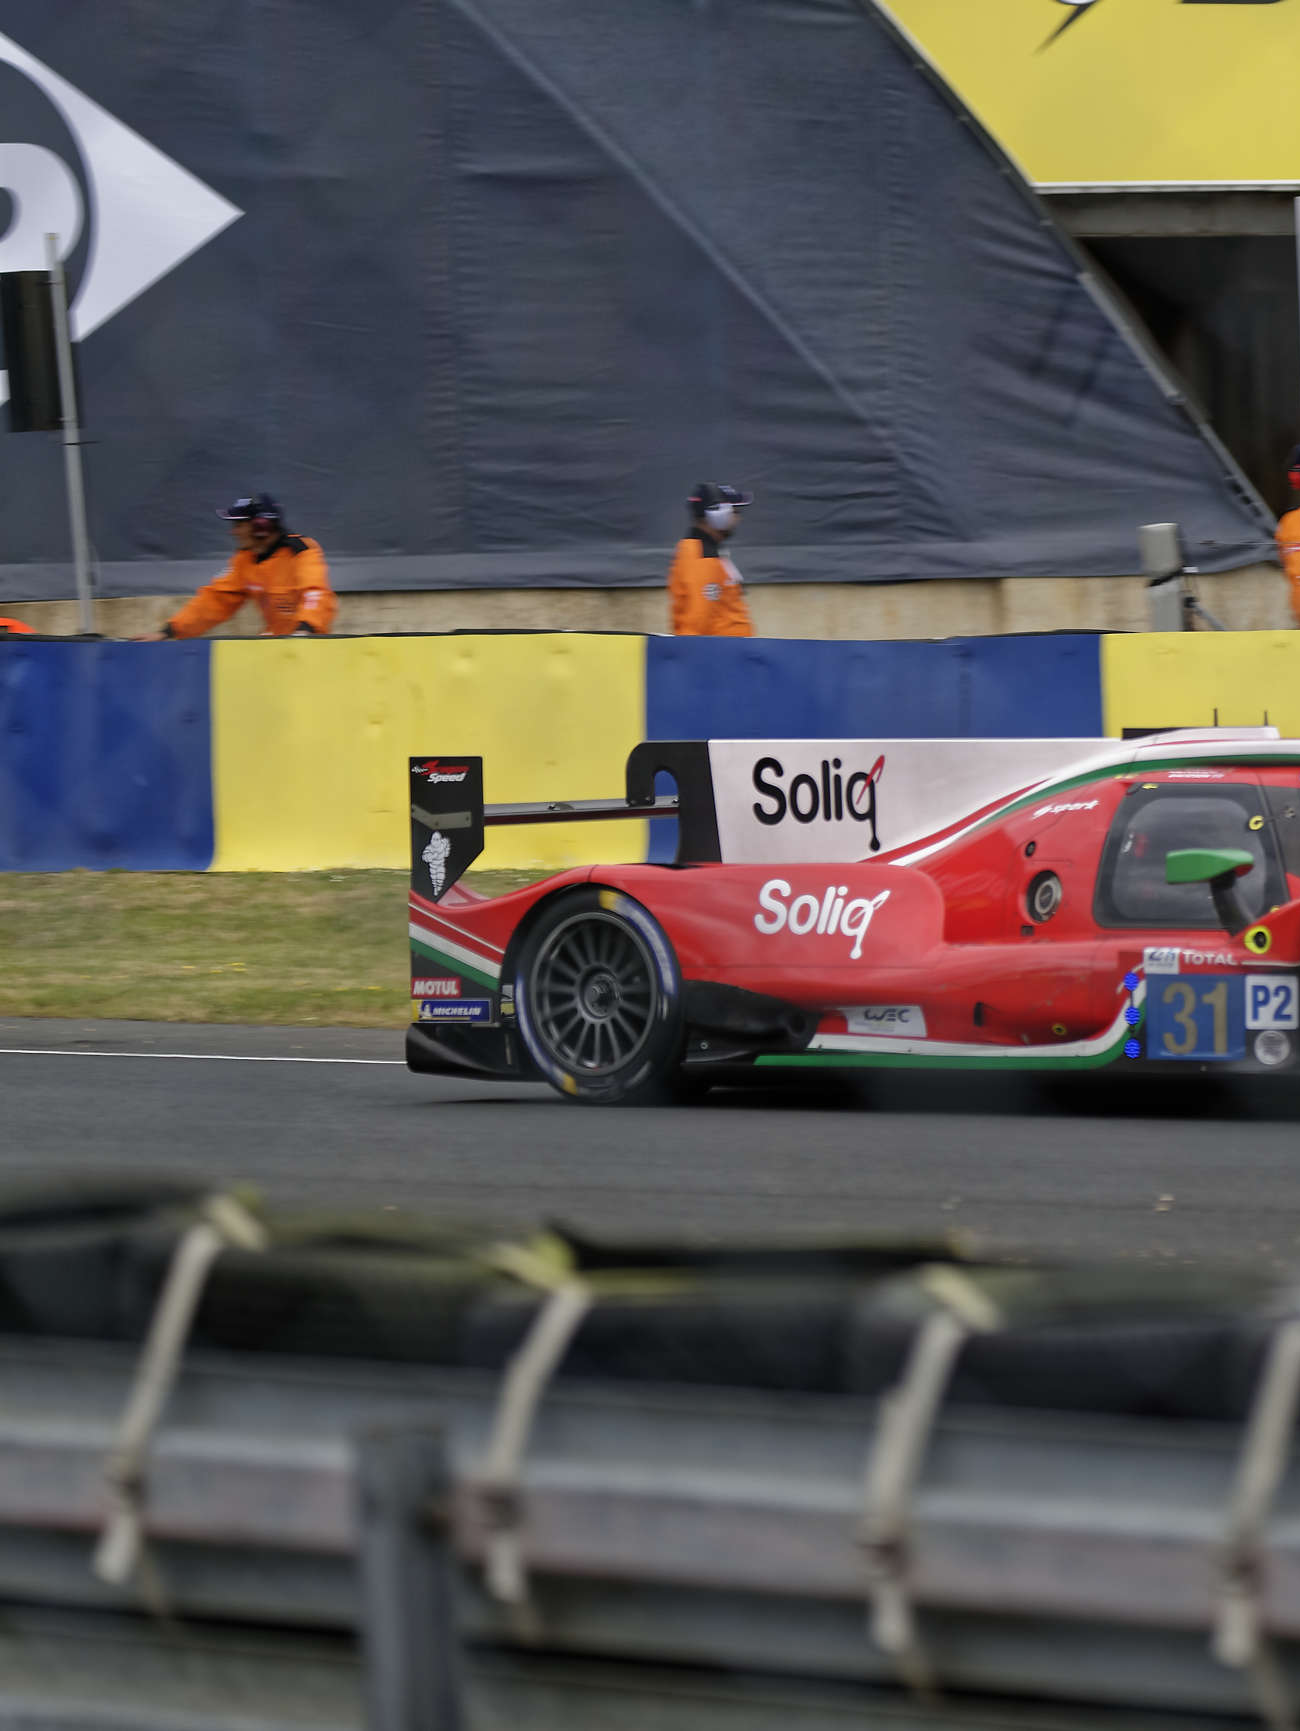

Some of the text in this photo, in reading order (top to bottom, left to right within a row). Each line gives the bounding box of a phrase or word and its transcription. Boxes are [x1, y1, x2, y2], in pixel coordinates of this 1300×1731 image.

[752, 754, 886, 852] Soliq
[754, 879, 891, 960] Soliq
[1181, 951, 1238, 966] TOTAL
[413, 980, 459, 995] MOTUL
[1251, 985, 1293, 1022] P2
[432, 1007, 481, 1016] MICHELIN
[1162, 982, 1228, 1055] 31
